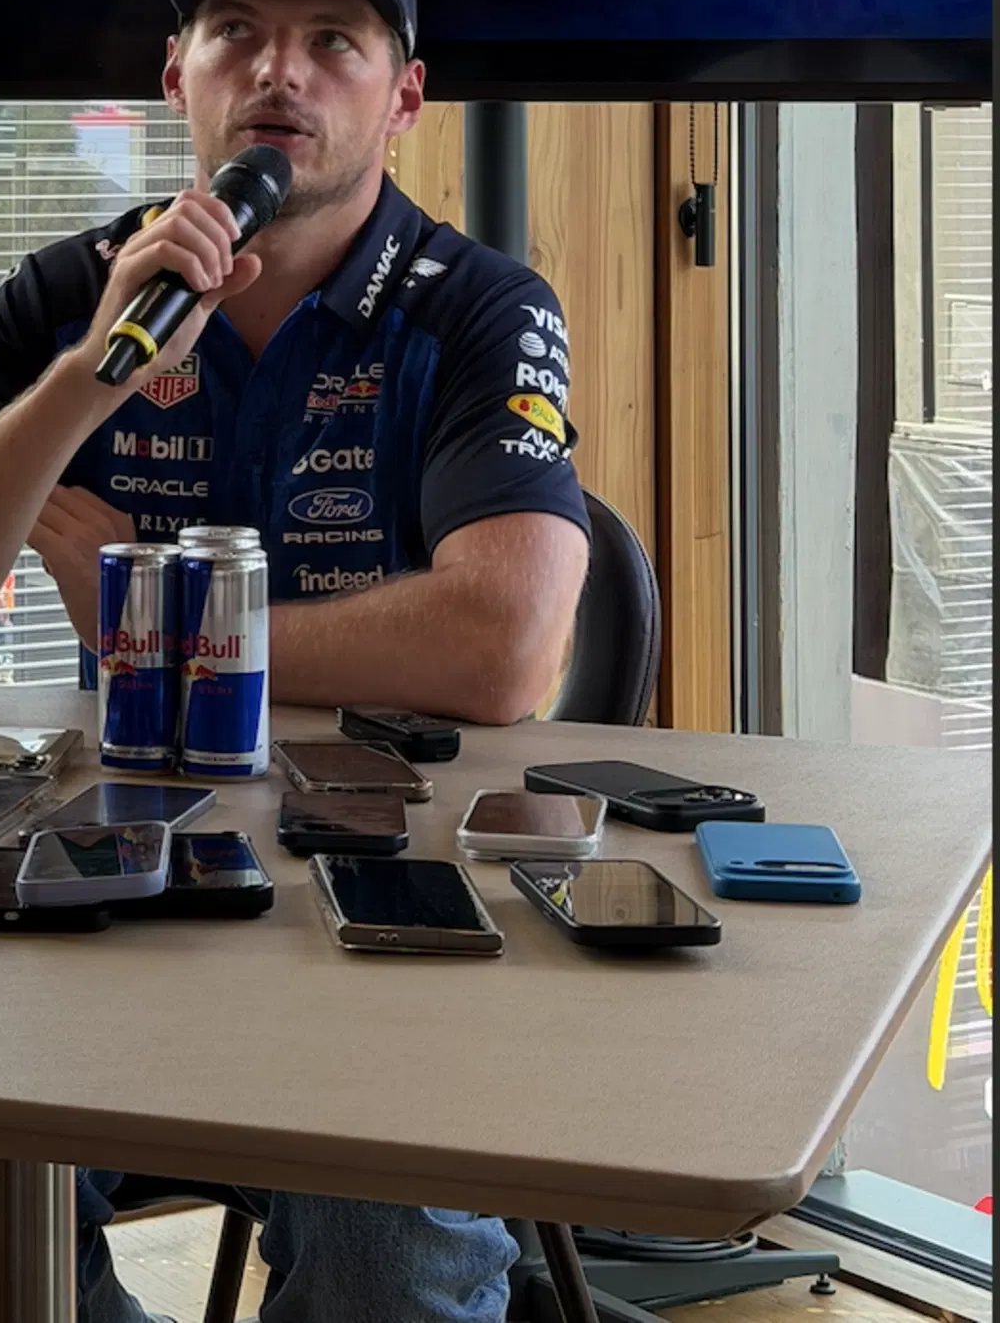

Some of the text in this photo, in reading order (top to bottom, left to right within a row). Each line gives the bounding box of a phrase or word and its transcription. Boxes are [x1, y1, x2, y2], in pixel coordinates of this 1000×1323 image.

[357, 234, 401, 319] DAMAC
[312, 362, 385, 392] ORLE
[111, 429, 185, 462] Mobil
[309, 445, 376, 474] Gate
[110, 474, 209, 498] ORACLE
[306, 491, 364, 520] Ford
[282, 528, 385, 545] RACING
[295, 563, 384, 593] indeed
[116, 631, 160, 654] Bull
[196, 635, 240, 659] Bull
